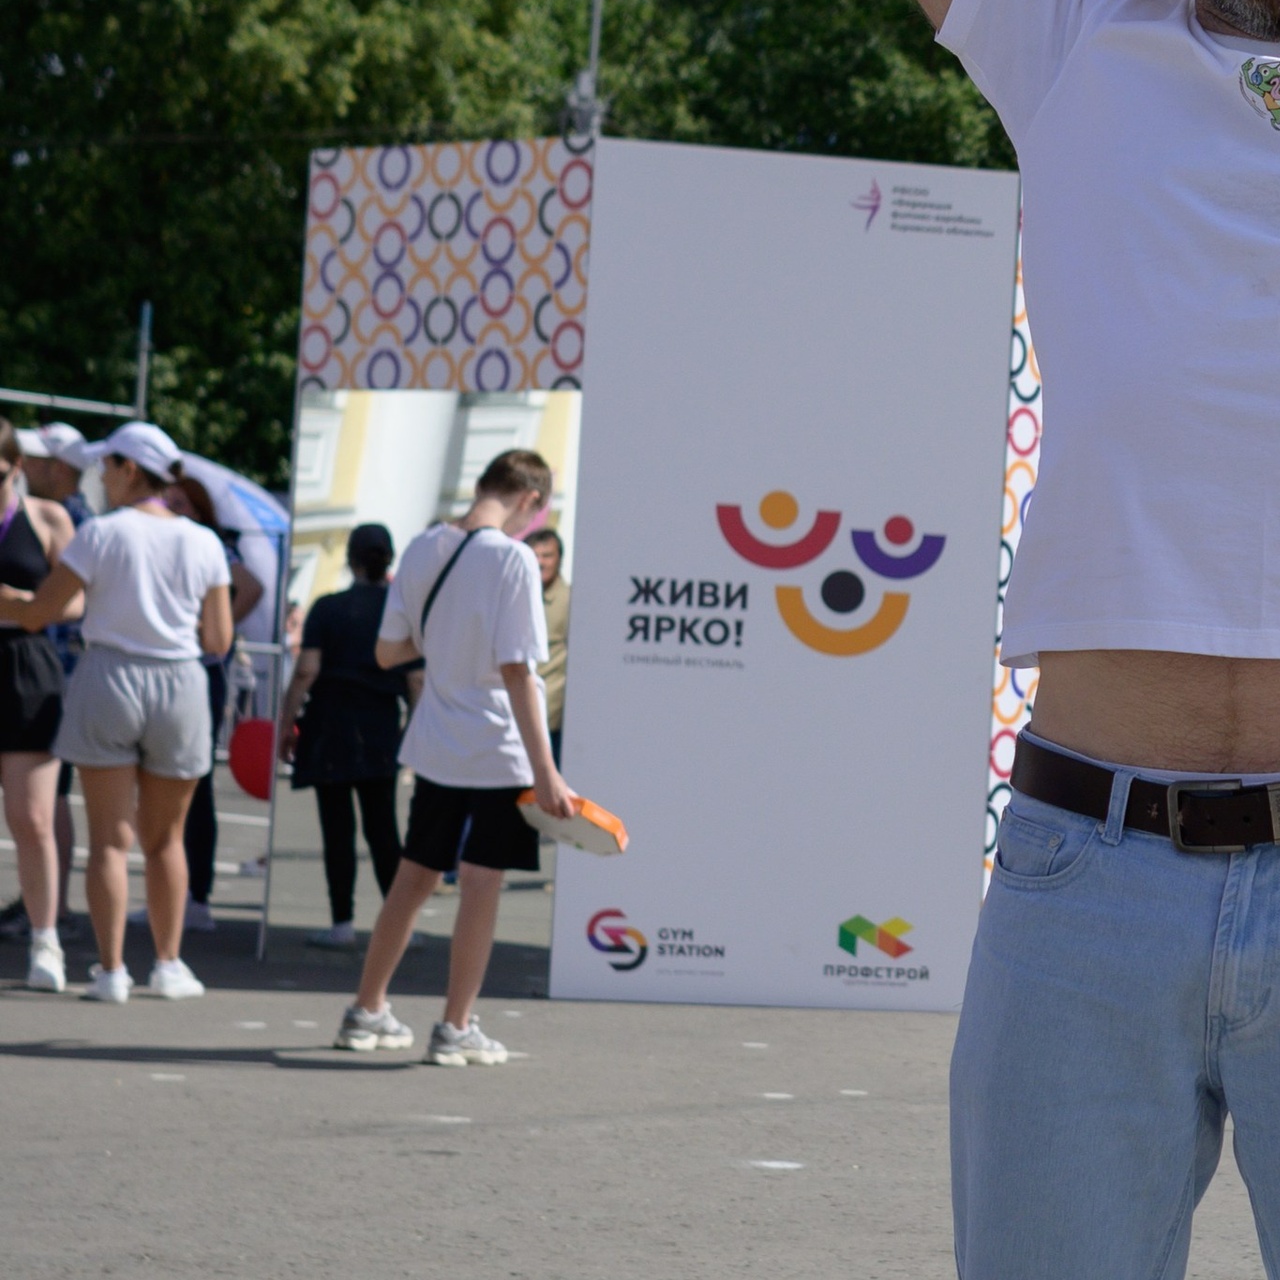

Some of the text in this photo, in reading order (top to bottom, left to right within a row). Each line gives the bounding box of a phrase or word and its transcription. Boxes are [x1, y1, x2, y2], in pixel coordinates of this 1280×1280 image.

[628, 575, 749, 611] ЖИВИ
[626, 614, 744, 648] ЯРКО!
[657, 927, 694, 942] GYM
[657, 942, 726, 958] STATION
[823, 963, 930, 981] ПРОФСТРОЙ
